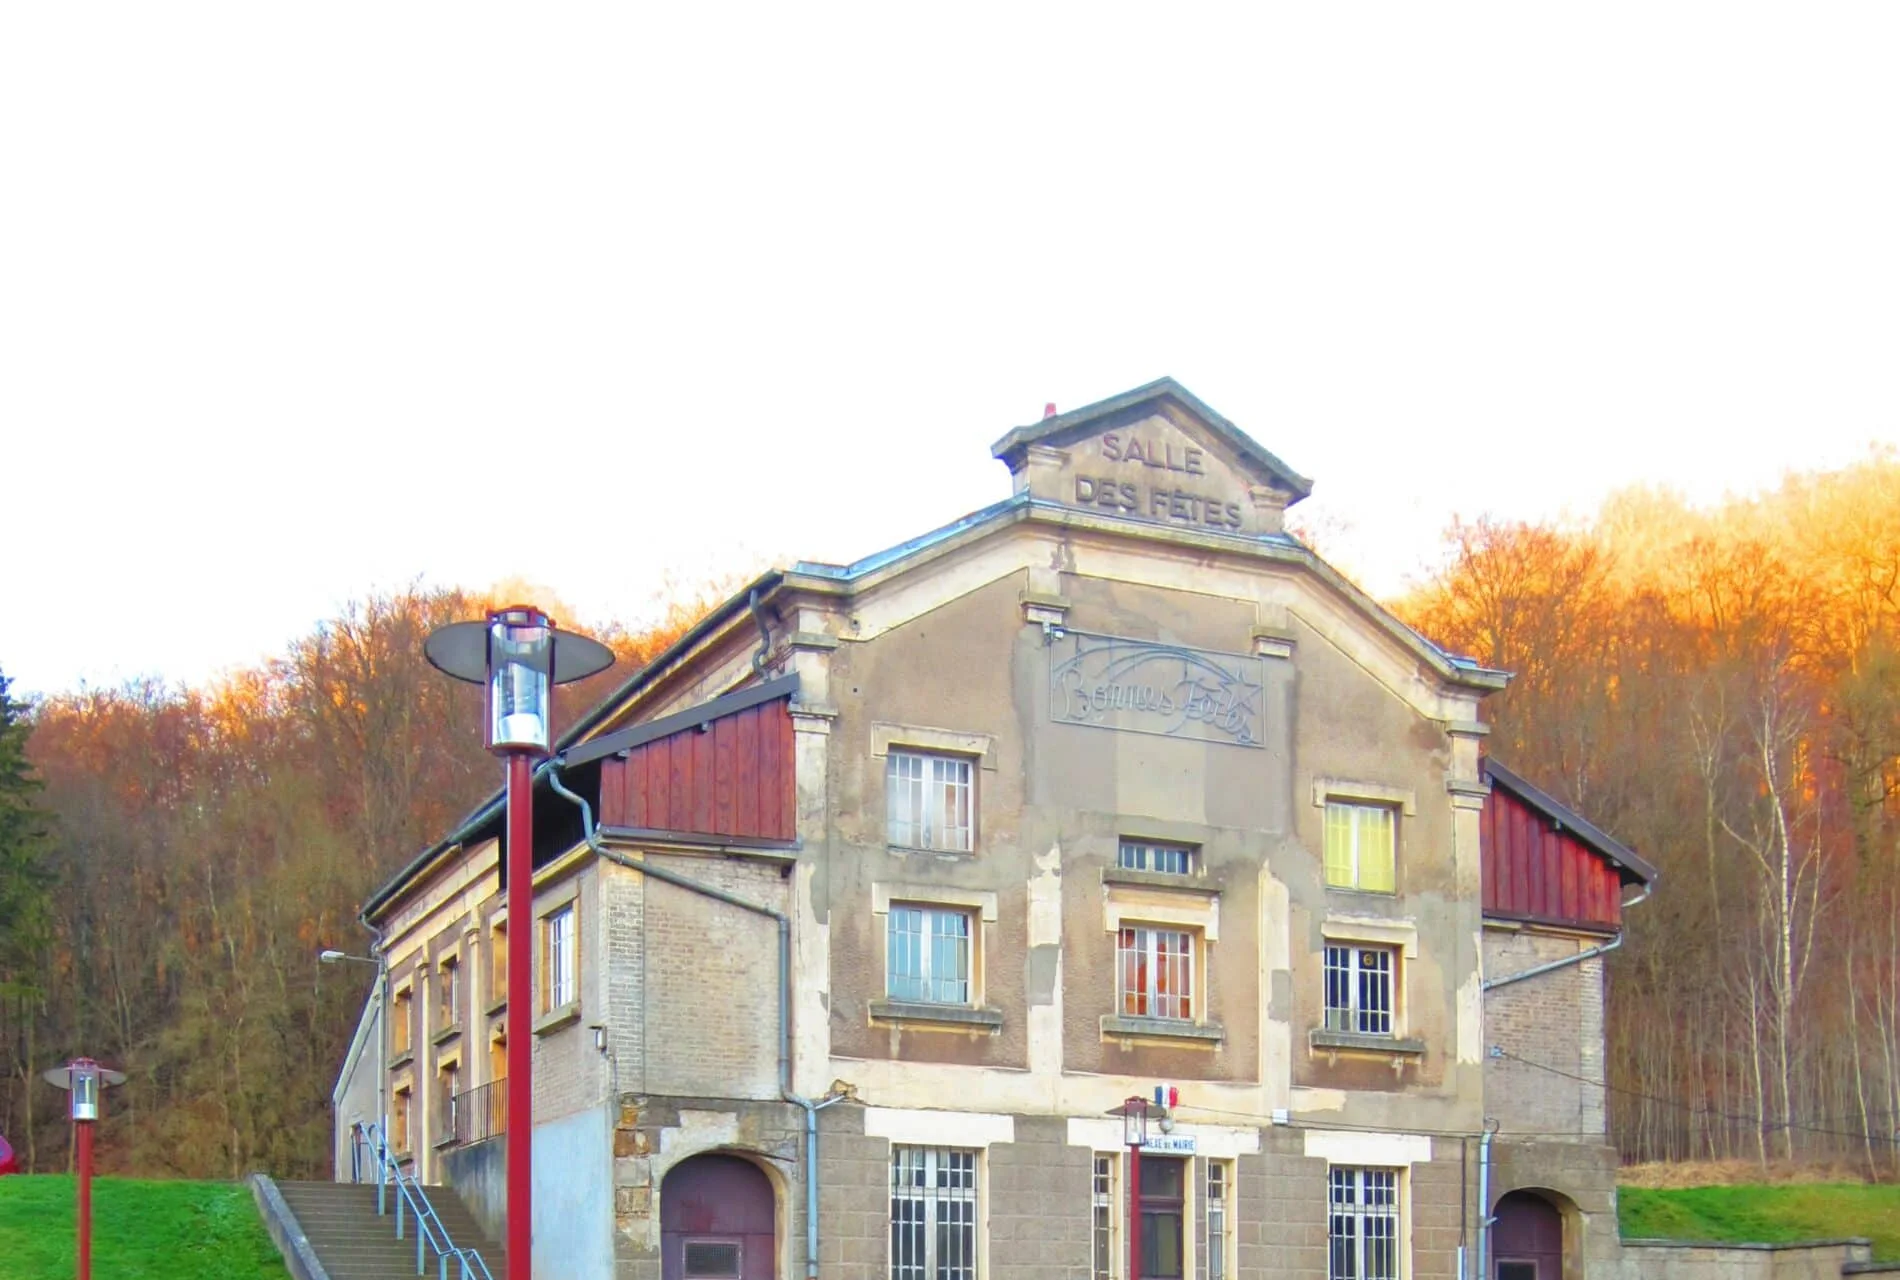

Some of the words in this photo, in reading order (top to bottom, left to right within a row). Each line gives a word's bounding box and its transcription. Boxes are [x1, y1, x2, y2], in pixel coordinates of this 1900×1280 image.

[1103, 432, 1204, 475] SALLE
[1075, 474, 1137, 510] DES
[1151, 487, 1242, 528] FÊTES
[1062, 668, 1175, 719] Bonnes
[1172, 1138, 1194, 1151] MAIRIE
